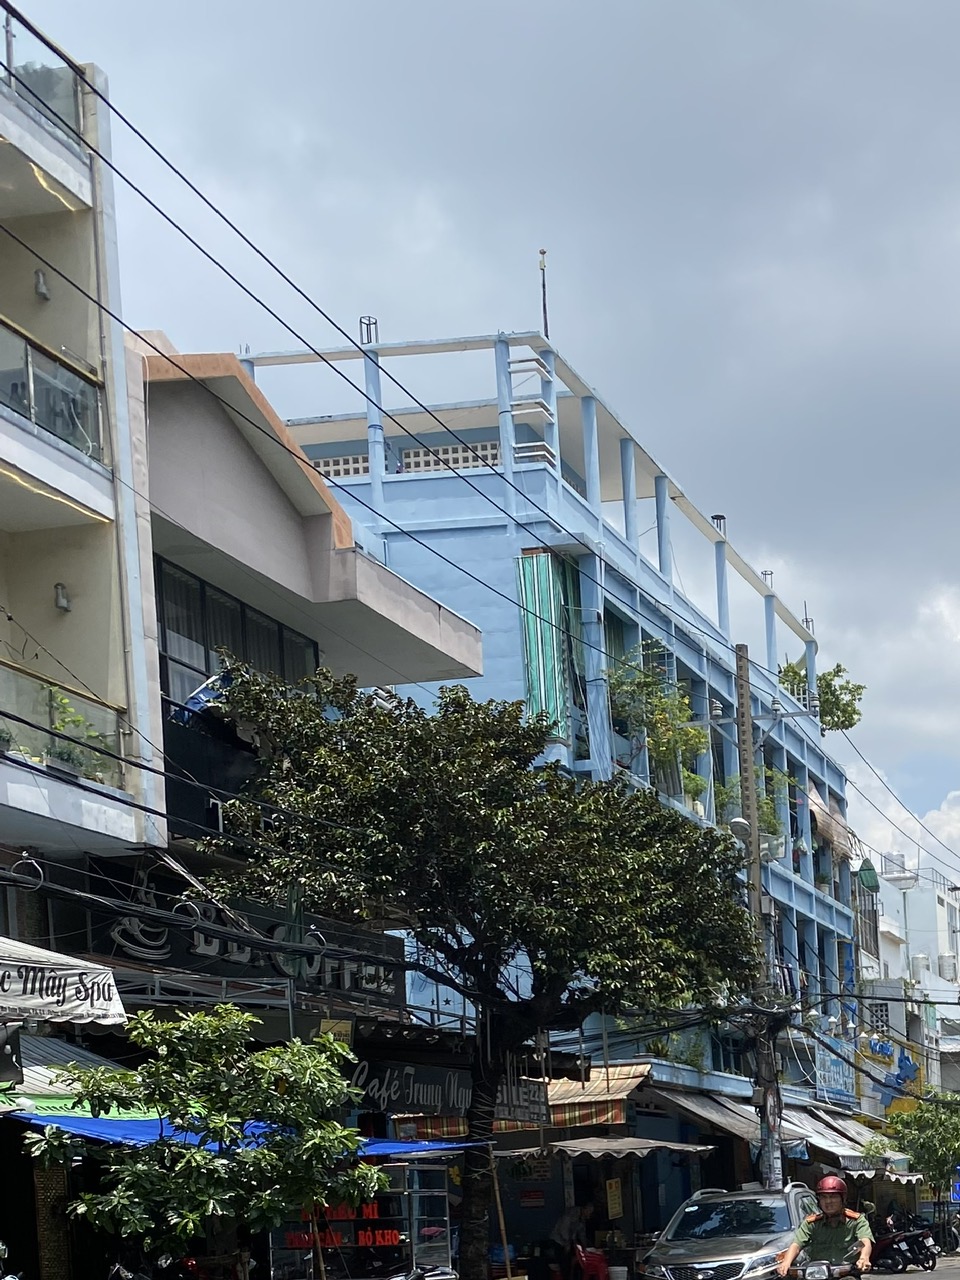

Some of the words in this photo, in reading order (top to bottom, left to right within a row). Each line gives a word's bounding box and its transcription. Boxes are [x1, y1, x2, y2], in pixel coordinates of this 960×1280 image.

[17, 965, 68, 1007] Mây
[75, 972, 115, 1008] Spa
[351, 1060, 400, 1110] Café
[403, 1066, 442, 1114] Trung
[375, 1229, 399, 1246] KHO
